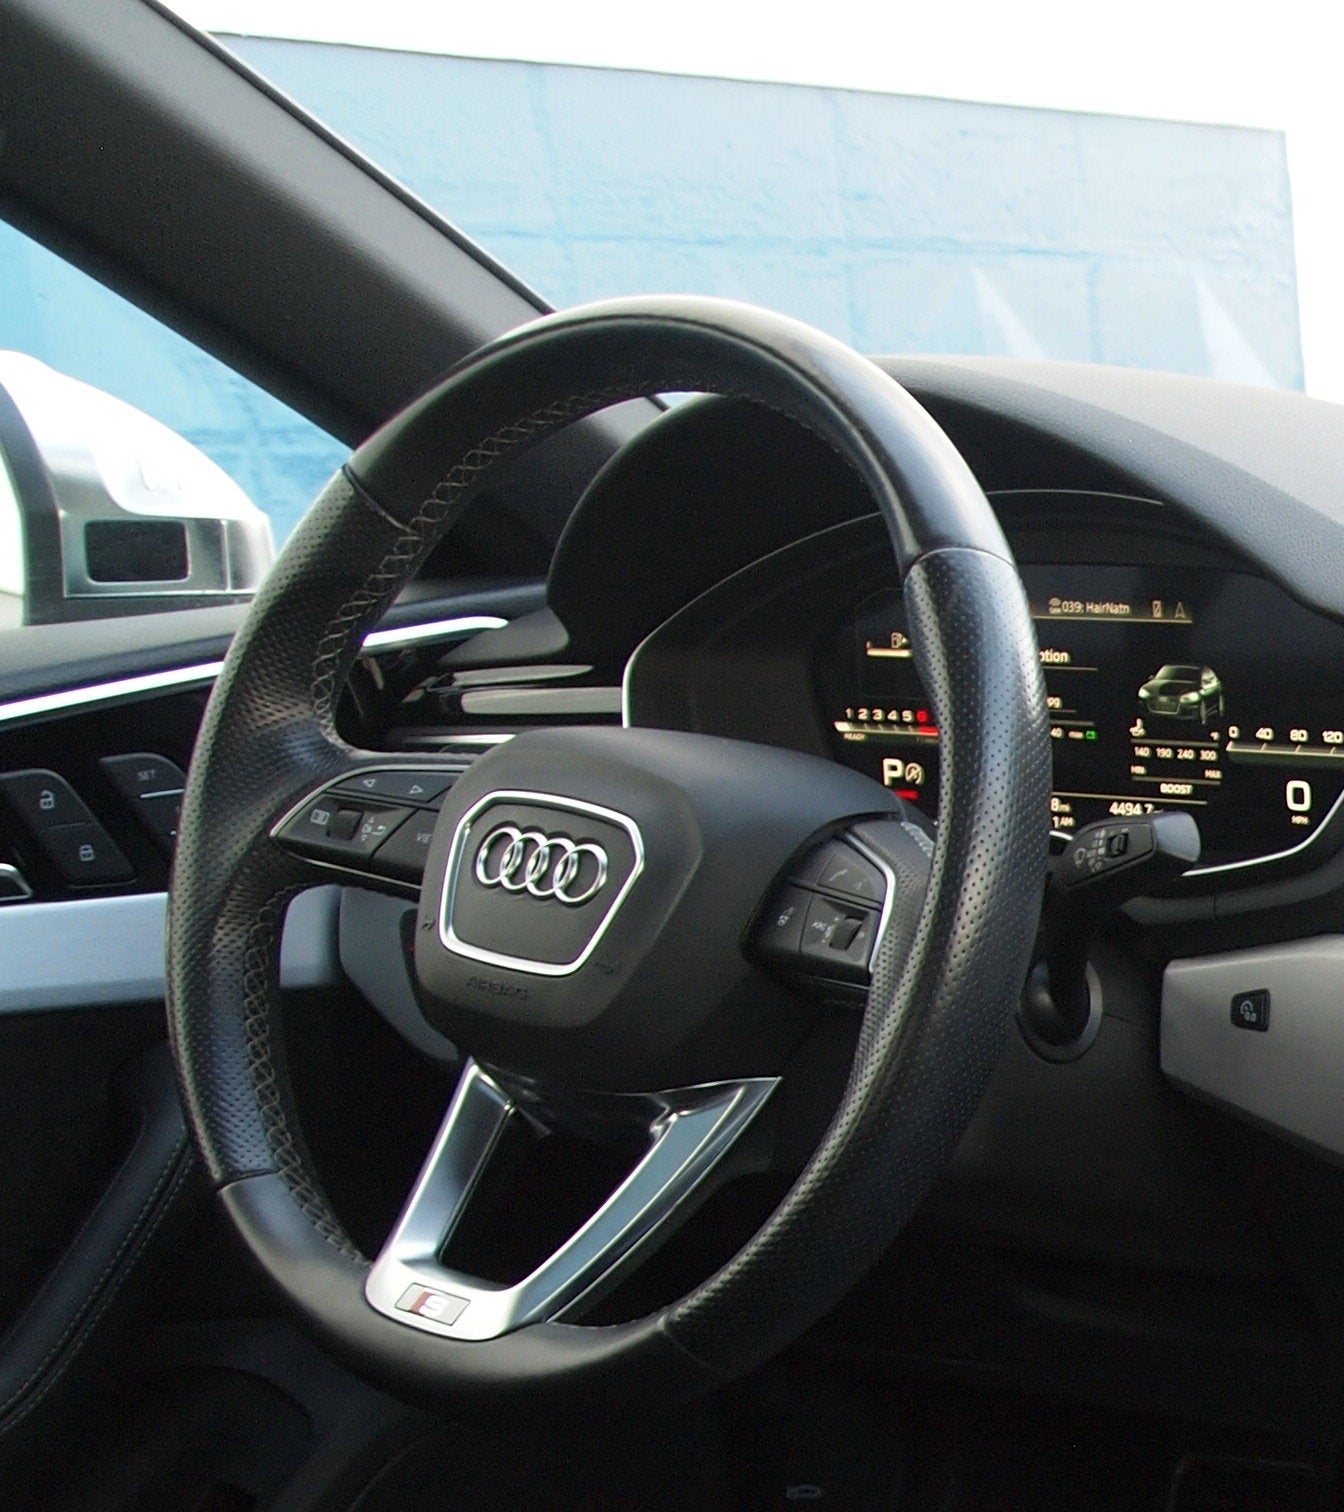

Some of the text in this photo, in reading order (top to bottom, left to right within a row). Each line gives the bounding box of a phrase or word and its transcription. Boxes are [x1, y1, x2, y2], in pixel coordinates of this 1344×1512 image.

[857, 708, 868, 720] 2
[872, 708, 883, 721] 3
[887, 709, 897, 721] 4
[902, 710, 912, 722] 5
[1229, 726, 1239, 739] 0
[1256, 727, 1274, 741] 40
[1290, 728, 1309, 743] 80
[1322, 730, 1344, 744] 120
[1134, 746, 1150, 757] 140
[1177, 748, 1194, 760] 240
[883, 757, 903, 787] P
[1160, 782, 1194, 795] BOOST
[1286, 780, 1311, 812] 0
